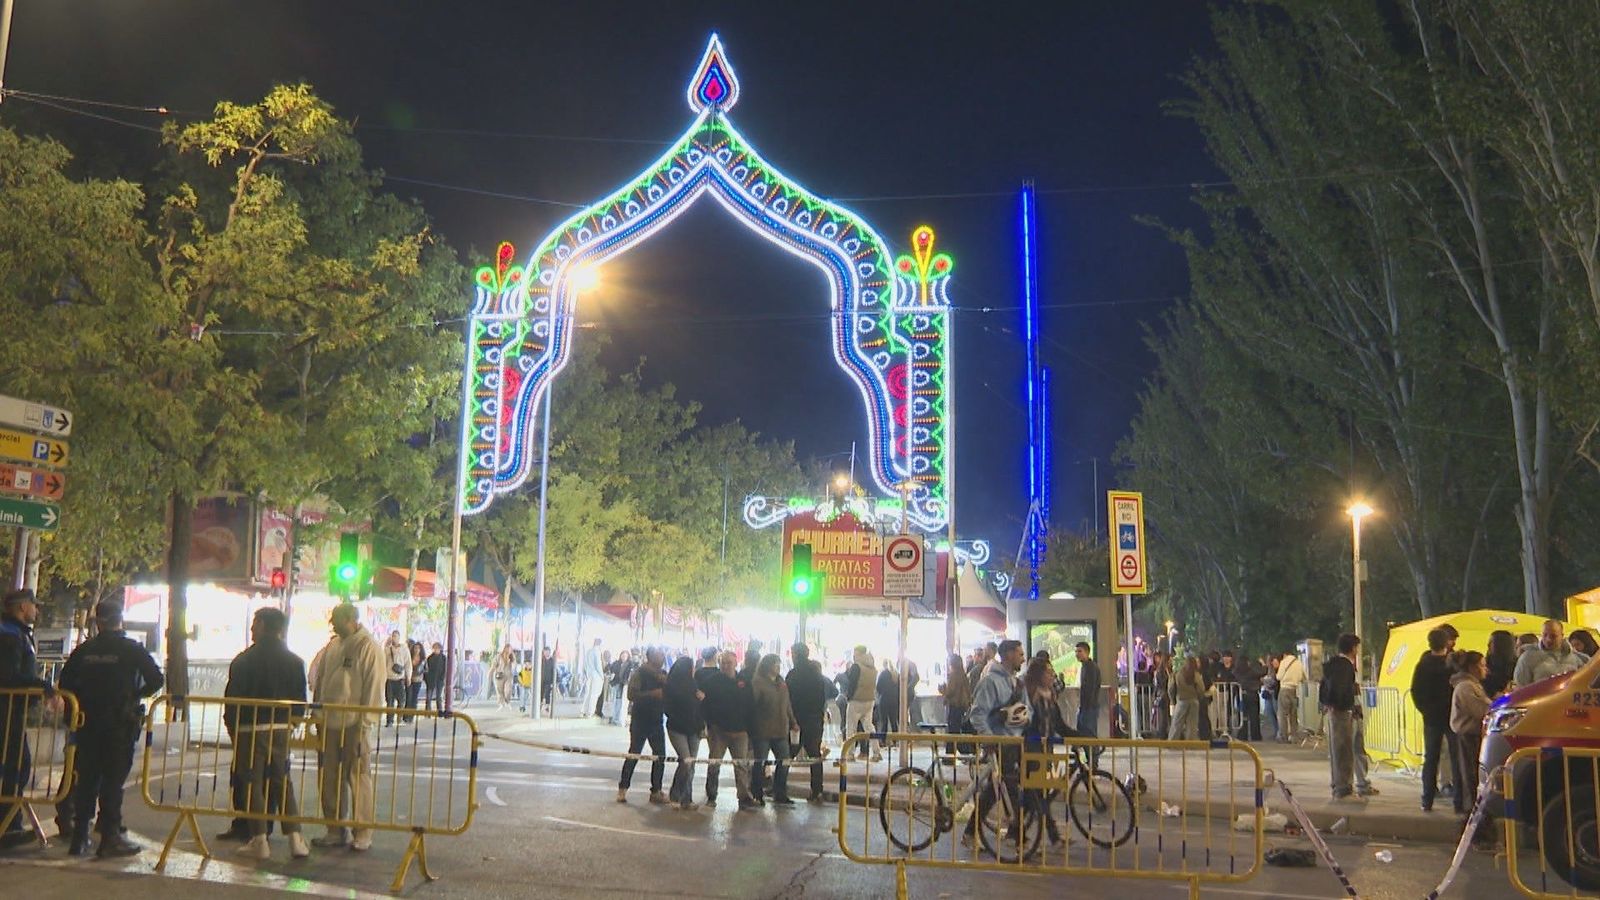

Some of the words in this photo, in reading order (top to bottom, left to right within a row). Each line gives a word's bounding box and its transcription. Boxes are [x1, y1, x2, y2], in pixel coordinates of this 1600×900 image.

[37, 443, 48, 458] P
[1117, 501, 1135, 511] CARRIL
[817, 559, 871, 574] PATATAS
[824, 574, 875, 589] RRITOS
[1026, 759, 1066, 779] PM
